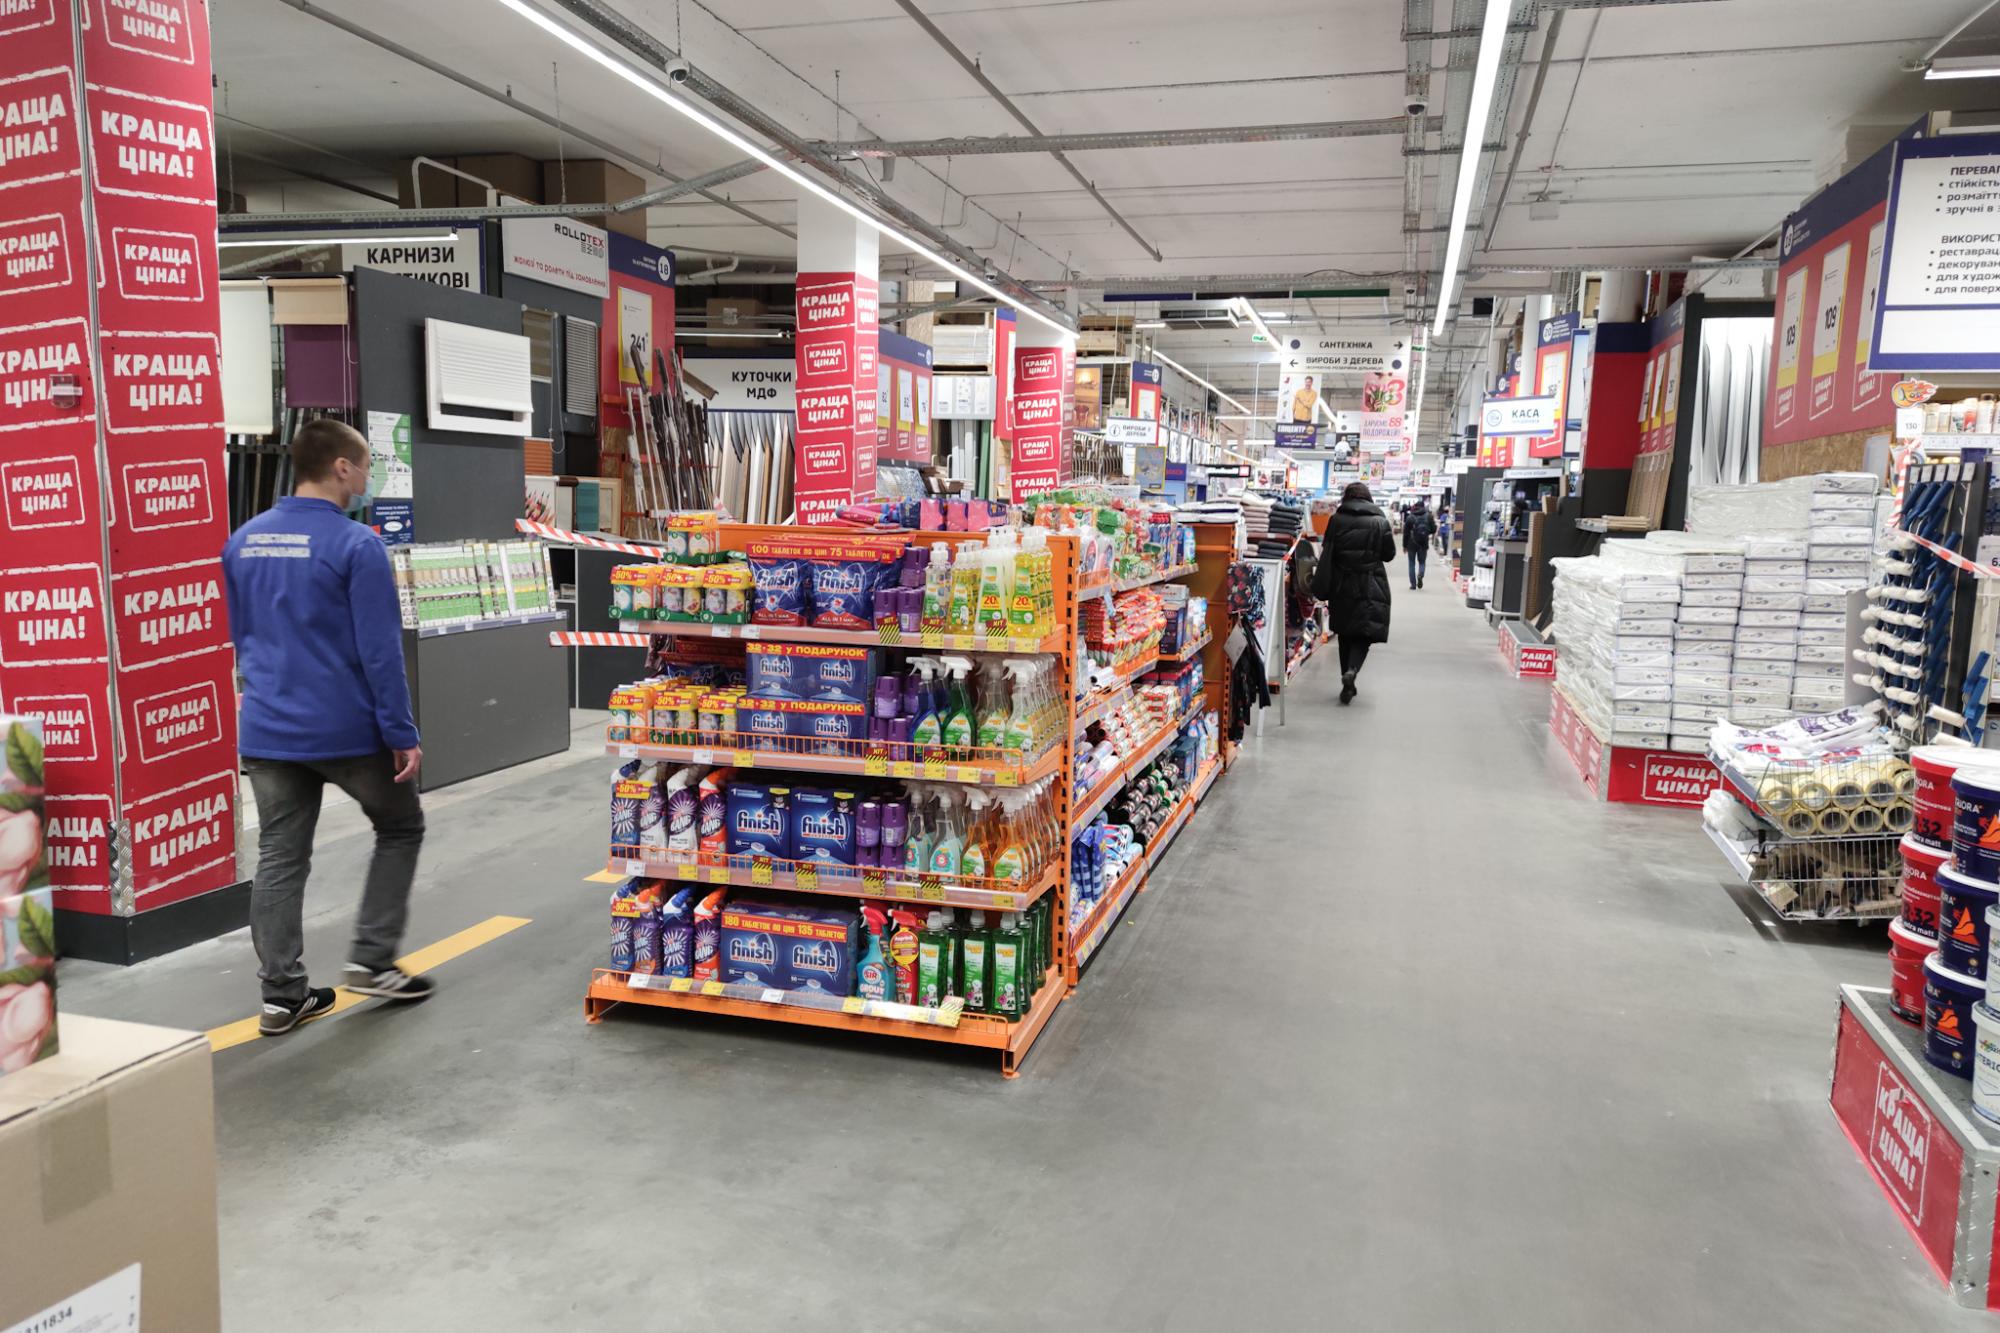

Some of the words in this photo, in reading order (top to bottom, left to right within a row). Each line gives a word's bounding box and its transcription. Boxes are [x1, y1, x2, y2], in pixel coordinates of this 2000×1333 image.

[122, 15, 176, 43] ЦІНА!
[101, 110, 203, 152] КРАЩА
[118, 145, 194, 179] ЦІНА!
[1945, 204, 1985, 215] зручні
[1987, 205, 1994, 213] в
[554, 223, 605, 249] ROLLOTEX
[124, 244, 192, 266] КРАЩА
[366, 246, 455, 265] КАРНИЗИ
[7, 252, 54, 278] ЦІНА!
[659, 262, 669, 275] 18
[136, 266, 187, 285] ЦІНА!
[1935, 274, 1959, 282] для
[1934, 286, 1957, 294] для
[802, 292, 850, 307] КРАЩА
[808, 306, 846, 322] ЦІНА!
[1319, 341, 1373, 349] САНТЕХНІКА
[809, 348, 843, 359] КРАЩА
[1350, 357, 1384, 365] ДЕРЕВА
[113, 354, 211, 380] КРАЩА
[814, 358, 839, 368] ЦІНА!
[1025, 358, 1053, 368] КРАЩА
[1029, 366, 1050, 375] ЦІНА!
[731, 371, 792, 383] КУТОЧКИ
[129, 383, 203, 411] ЦІНА!
[747, 388, 777, 401] МДФ
[801, 395, 849, 410] КРАЩА
[1018, 398, 1057, 410] КРАЩА
[808, 408, 845, 423] ЦІНА!
[1022, 409, 1053, 421] ЦІНА!
[1511, 409, 1540, 418] КАСА
[1022, 440, 1050, 449] КРАЩА
[1026, 448, 1047, 457] ЦІНА!
[808, 449, 842, 460] КРАЩА
[813, 458, 838, 468] ЦІНА!
[12, 472, 73, 493] КРАЩА
[134, 474, 201, 494] КРАЩА
[1015, 476, 1054, 488] КРАЩА
[21, 493, 68, 514] ЦІНА!
[145, 494, 196, 516] ЦІНА!
[800, 498, 848, 511] КРАЩА
[752, 545, 769, 554] 100
[830, 547, 843, 557] 75
[4, 587, 94, 614] КРАЩА
[124, 580, 221, 616] КРАЩА
[18, 616, 86, 646] ЦІНА!
[140, 608, 212, 645] ЦІНА!
[795, 645, 865, 658] ПОДАРУНОК
[1520, 652, 1553, 661] РАЩА
[760, 657, 791, 671] finish
[820, 662, 852, 678] finish
[145, 697, 211, 727] КРАЩА
[790, 702, 863, 713] ПОДАРУНОК
[752, 712, 784, 729] finish
[815, 717, 848, 733] finish
[156, 716, 205, 744] ЦІНА!
[42, 730, 80, 748] ІНА!
[1648, 763, 1719, 782] КРАЩА
[1655, 780, 1710, 796] ЦІНА!
[134, 793, 229, 843] КРАЩА
[738, 810, 780, 830] finish
[802, 815, 845, 836] finish
[150, 821, 220, 866] ЦІНА!
[48, 846, 97, 867] ІНА!
[731, 939, 773, 961] finish
[793, 945, 836, 968] finish
[1879, 1126, 1916, 1191] ЦІНА!
